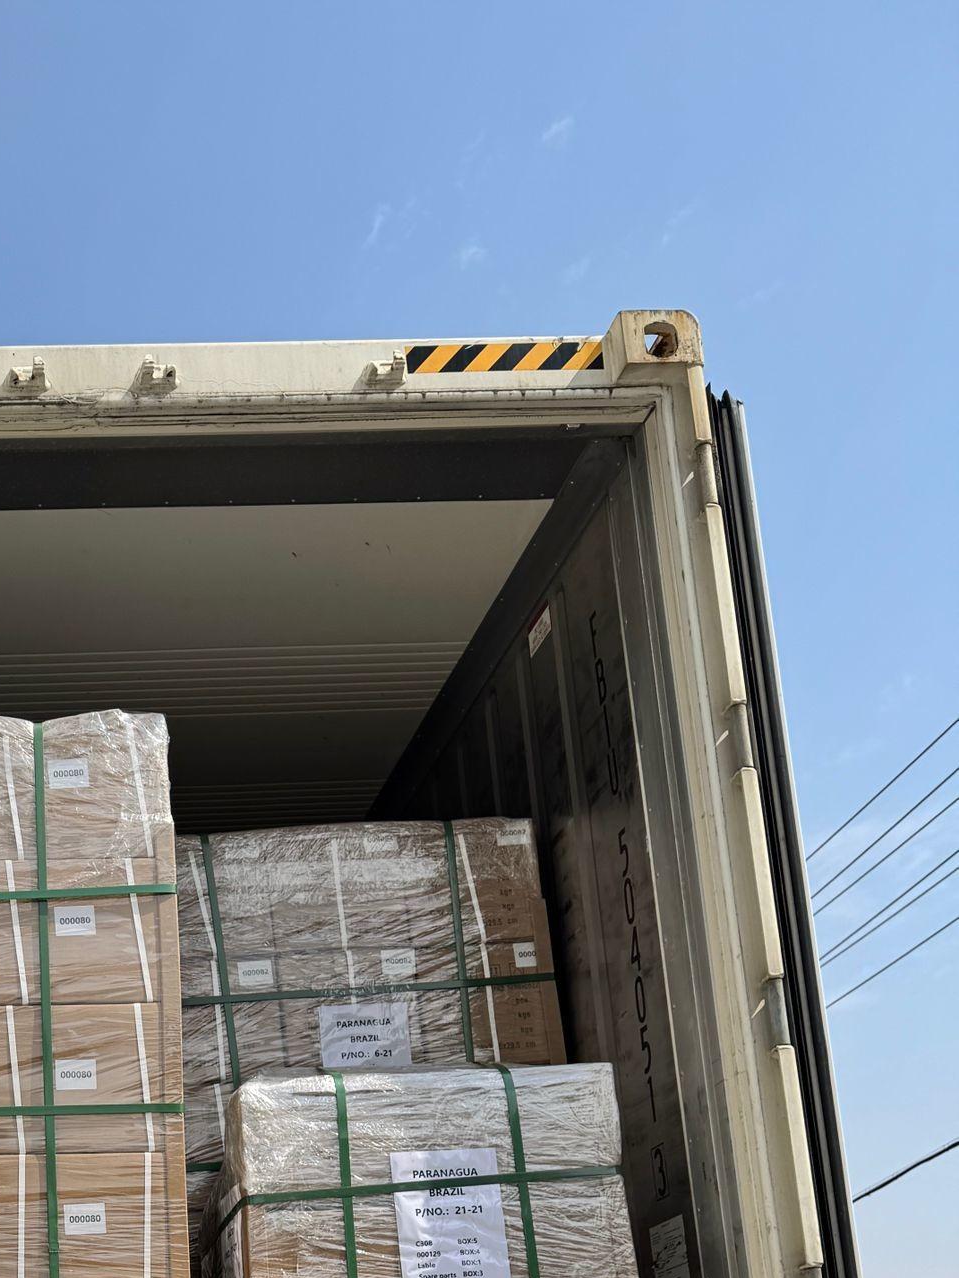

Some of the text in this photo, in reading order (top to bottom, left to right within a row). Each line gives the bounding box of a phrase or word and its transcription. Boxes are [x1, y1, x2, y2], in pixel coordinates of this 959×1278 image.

[52, 767, 85, 779] 000080
[589, 611, 620, 797] FBIU
[617, 826, 657, 1122] 504051
[58, 915, 91, 926] 000080
[336, 1018, 392, 1028] PARANAGUA
[350, 1034, 380, 1044] BRAZIL
[374, 1048, 393, 1058] 6-21
[59, 1069, 92, 1080] 000080
[413, 1168, 478, 1178] PARANAGUA
[429, 1187, 466, 1197] BRAZIL
[415, 1205, 483, 1218] P/NO.: 21-21
[68, 1213, 101, 1224] 000080
